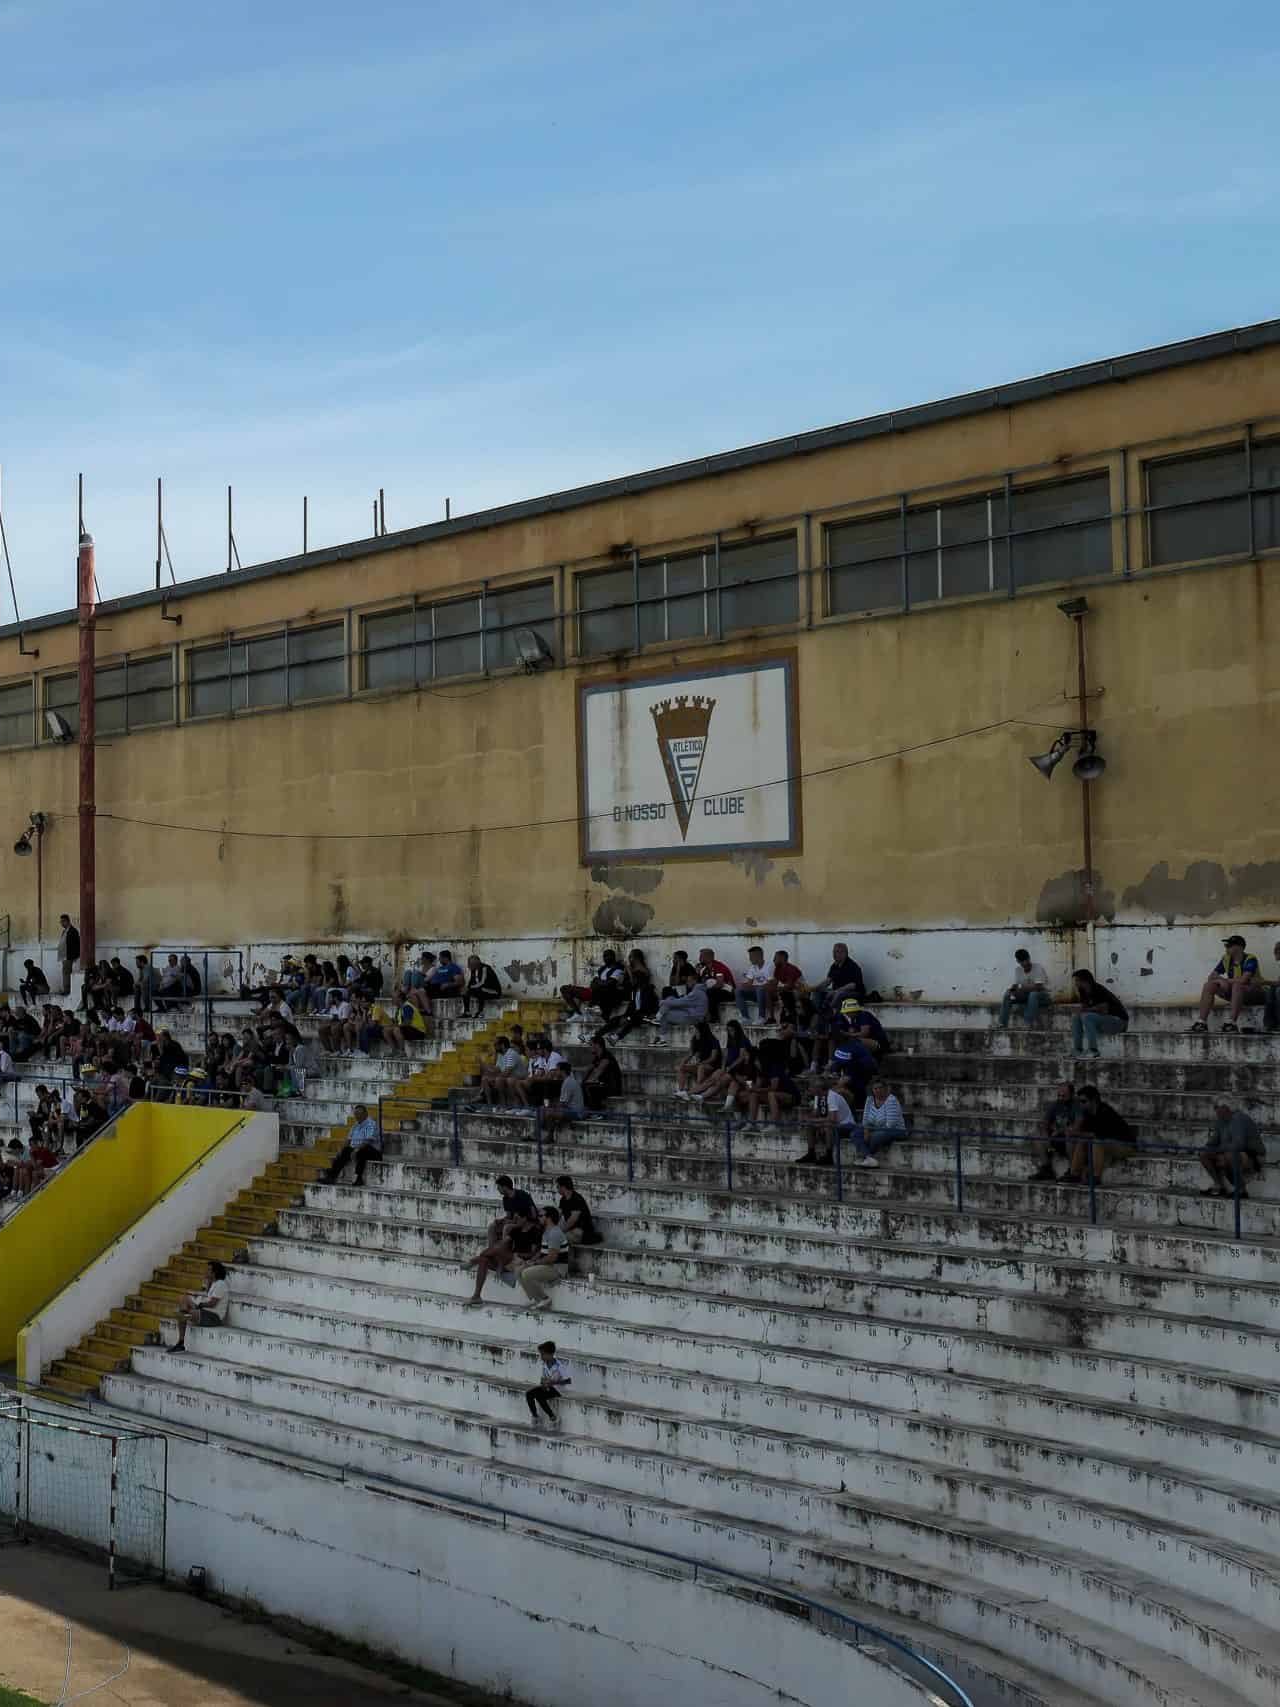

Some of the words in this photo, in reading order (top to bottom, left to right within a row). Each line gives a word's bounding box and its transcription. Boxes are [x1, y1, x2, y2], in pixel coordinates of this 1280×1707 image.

[613, 805, 621, 822] O
[625, 802, 666, 822] NOSSO
[703, 797, 745, 816] CLUBE
